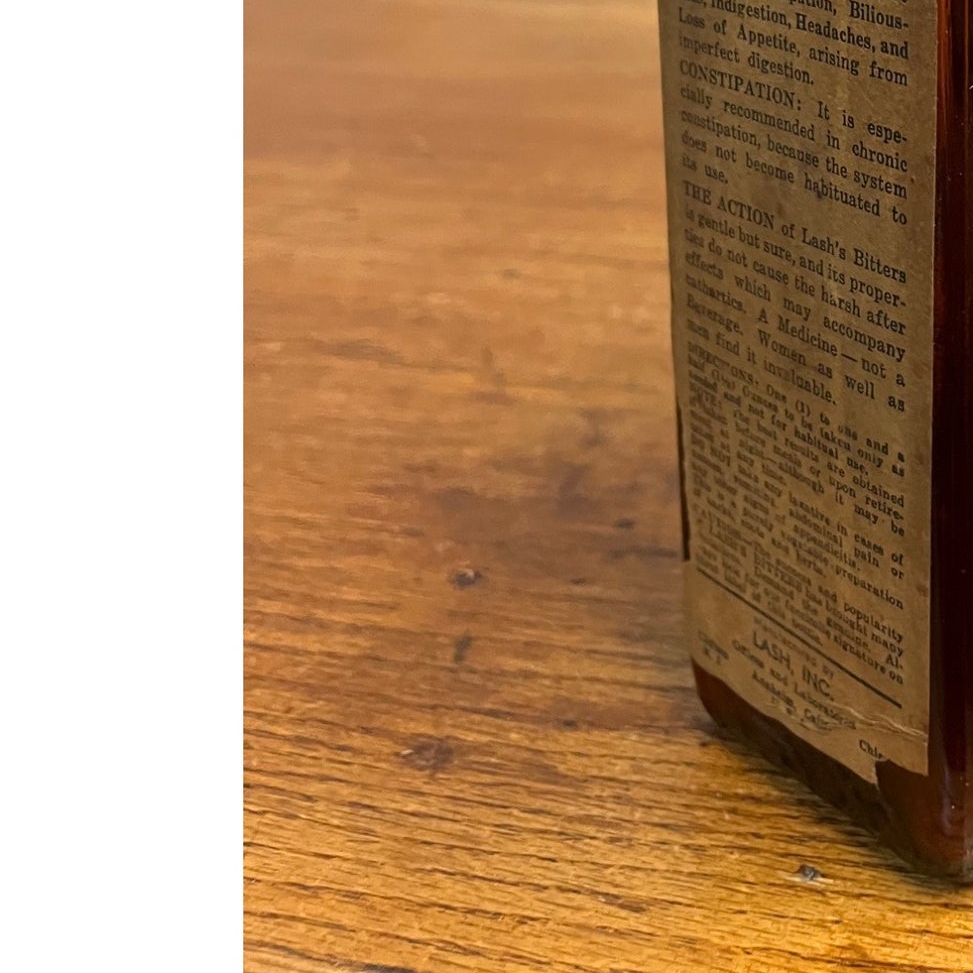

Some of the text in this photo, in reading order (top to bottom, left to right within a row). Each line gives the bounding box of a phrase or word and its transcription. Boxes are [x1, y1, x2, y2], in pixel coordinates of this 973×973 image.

[796, 13, 875, 52] Headaches,
[880, 41, 909, 60] and
[849, 0, 909, 29] Bilious-
[678, 7, 908, 86] Loss of Appetite, arising from
[679, 30, 814, 85] imperfect digestion.
[679, 60, 908, 142] CONSTIPATION: It is espe-
[680, 84, 907, 172] cially recommended in chronic
[681, 111, 907, 199] constipation, because the system
[681, 130, 907, 225] does not become habituated to
[682, 156, 728, 184] its use.
[682, 180, 906, 284] THE ACTION of Lash's Bitters
[698, 214, 735, 238] gentle
[738, 226, 760, 249] but
[763, 241, 796, 266] sure,
[799, 256, 824, 277] and
[827, 263, 845, 285] its
[850, 277, 906, 307] proper-
[708, 237, 722, 257] do
[727, 249, 748, 268] not
[753, 261, 789, 285] cause
[795, 275, 815, 297] the
[821, 285, 860, 318] harsh
[867, 310, 906, 335] after
[734, 275, 771, 302] which
[783, 297, 811, 322] may
[823, 317, 905, 362] accompany
[715, 332, 740, 356] find
[746, 346, 757, 365] it
[757, 308, 769, 324] A
[861, 358, 886, 379] not
[896, 373, 906, 387] a
[758, 329, 807, 366] Women
[817, 363, 833, 379] as
[844, 375, 875, 400] well
[888, 396, 905, 412] as
[766, 384, 787, 403] One
[819, 412, 830, 426] to
[866, 438, 889, 455] and
[897, 452, 905, 463] a
[784, 408, 795, 421] to
[801, 416, 813, 432] be
[857, 449, 883, 468] only
[891, 464, 905, 478] as
[794, 426, 838, 459] habitual
[809, 466, 821, 478] or
[829, 476, 856, 498] upon
[827, 462, 845, 478] are
[853, 475, 904, 508] obtained
[835, 491, 844, 506] it
[854, 504, 878, 524] may
[891, 520, 905, 537] be
[837, 521, 848, 537] in
[891, 553, 904, 566] of
[854, 547, 880, 568] pain
[891, 567, 904, 580] or
[835, 565, 903, 610] preparation
[844, 602, 903, 644] popularity
[871, 633, 904, 657] many
[753, 631, 794, 676] LASH,
[802, 666, 834, 701] INC.
[889, 671, 903, 686] on
